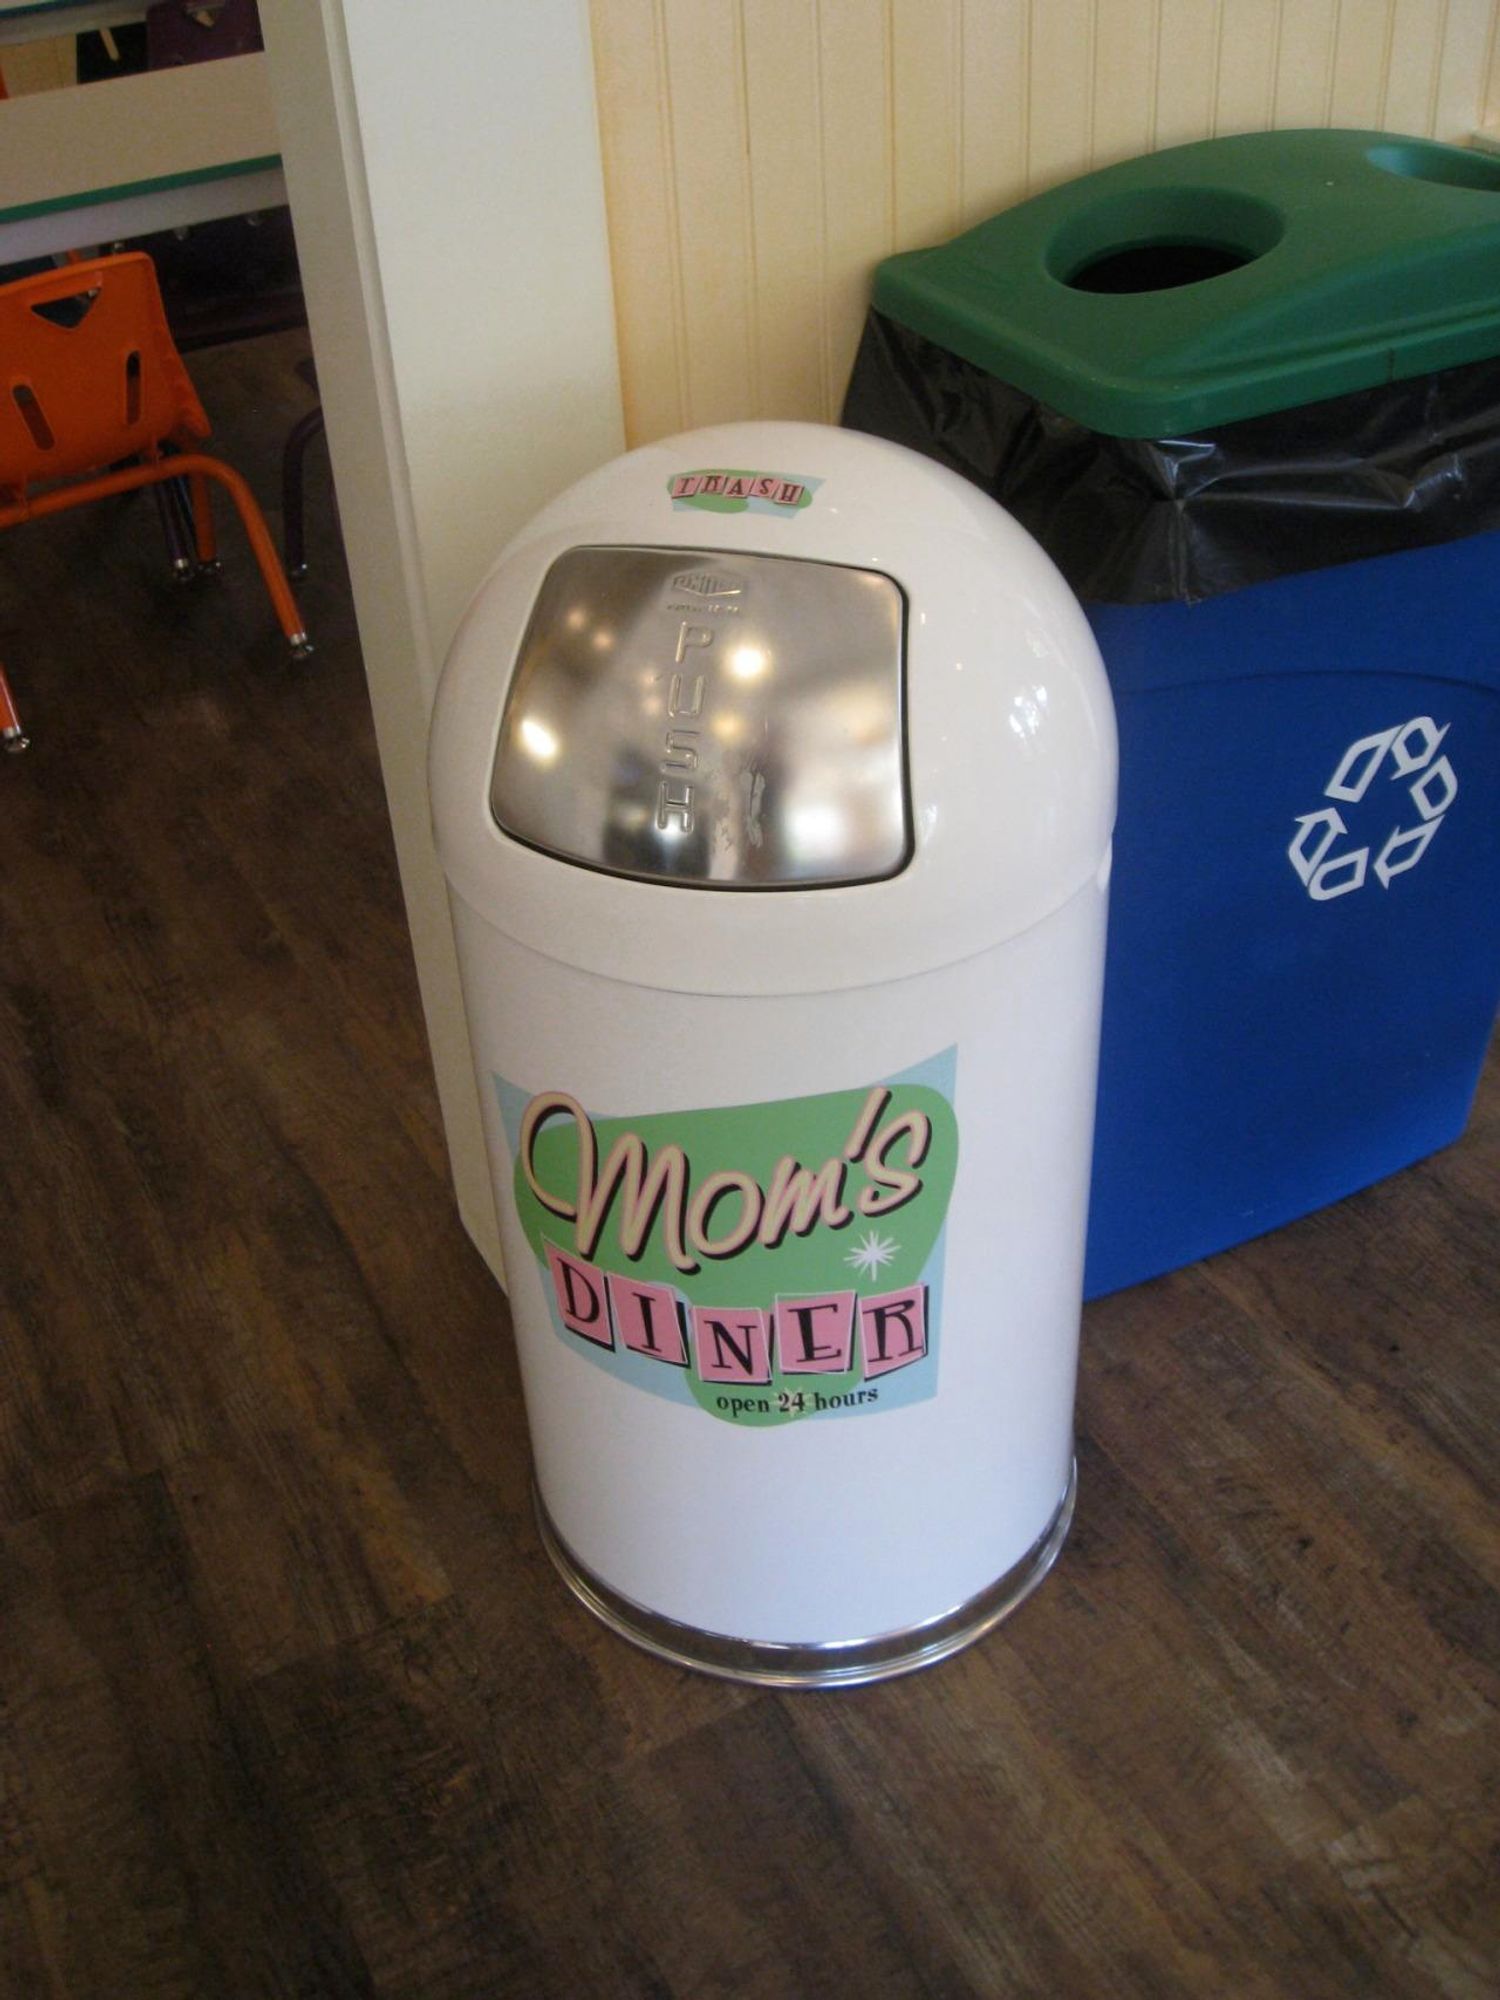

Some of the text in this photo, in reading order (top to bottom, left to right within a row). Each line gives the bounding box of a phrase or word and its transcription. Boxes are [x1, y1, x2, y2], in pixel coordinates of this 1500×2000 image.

[679, 475, 802, 503] TRASH
[654, 620, 713, 832] PUSH
[520, 1087, 931, 1274] Mom's
[556, 1256, 925, 1376] DINER
[716, 1387, 879, 1417] open 24 hours
